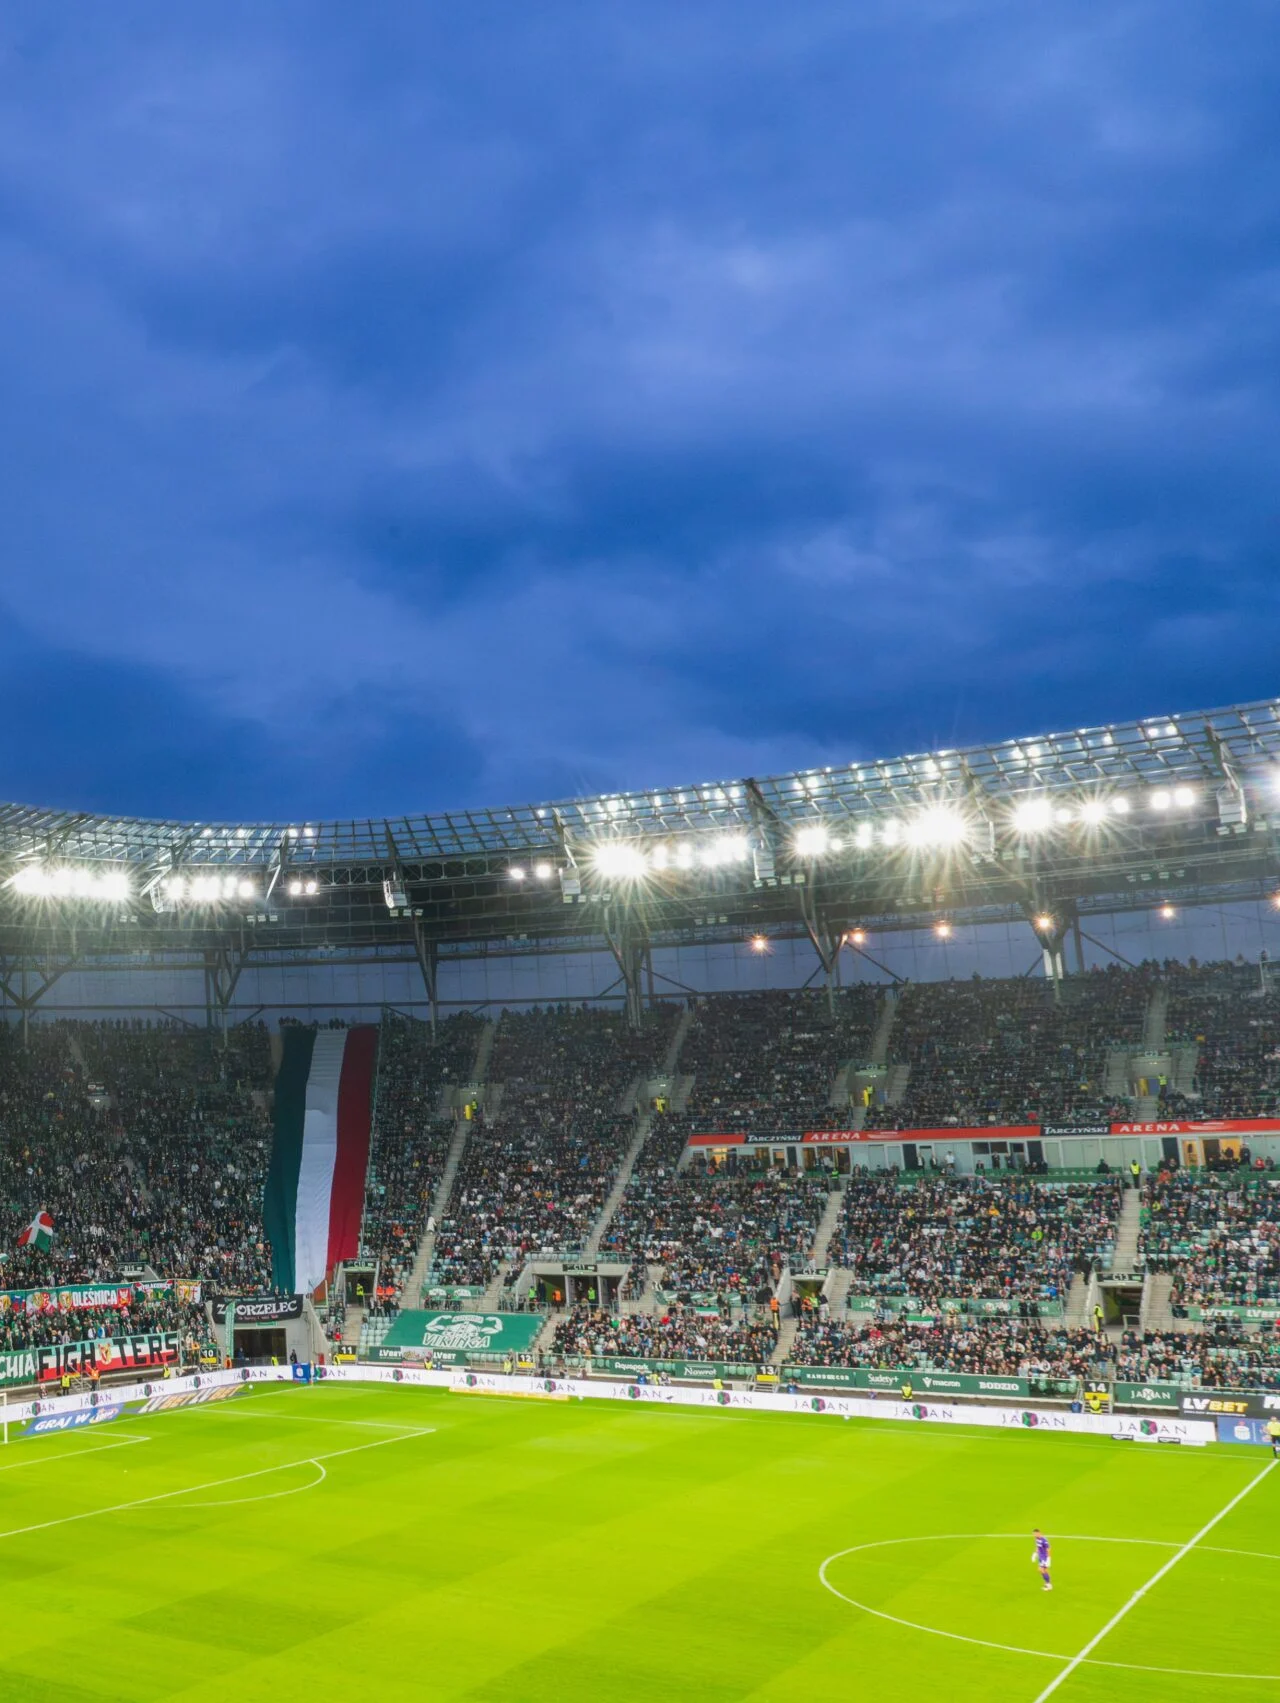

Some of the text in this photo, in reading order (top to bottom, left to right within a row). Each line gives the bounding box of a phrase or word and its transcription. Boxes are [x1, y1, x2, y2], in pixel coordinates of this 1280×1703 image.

[1044, 1122, 1181, 1135] TARCZYŃSKI ARENA
[747, 1131, 861, 1143] TARCZYŃSKI ARENA
[72, 1288, 118, 1308] OLEŚNICA
[217, 1300, 297, 1316] ZORZELEC
[204, 1349, 214, 1357] 10
[340, 1346, 354, 1355] 11
[38, 1333, 179, 1380] FIGHTERS
[519, 1354, 533, 1362] 12
[684, 1366, 717, 1376] Nawrot
[760, 1366, 775, 1375] 13
[933, 1379, 961, 1388] macron
[979, 1381, 1020, 1391] BODZIO
[1088, 1382, 1107, 1393] 14
[1182, 1397, 1249, 1413] LVBET
[34, 1415, 73, 1432] GRAJ
